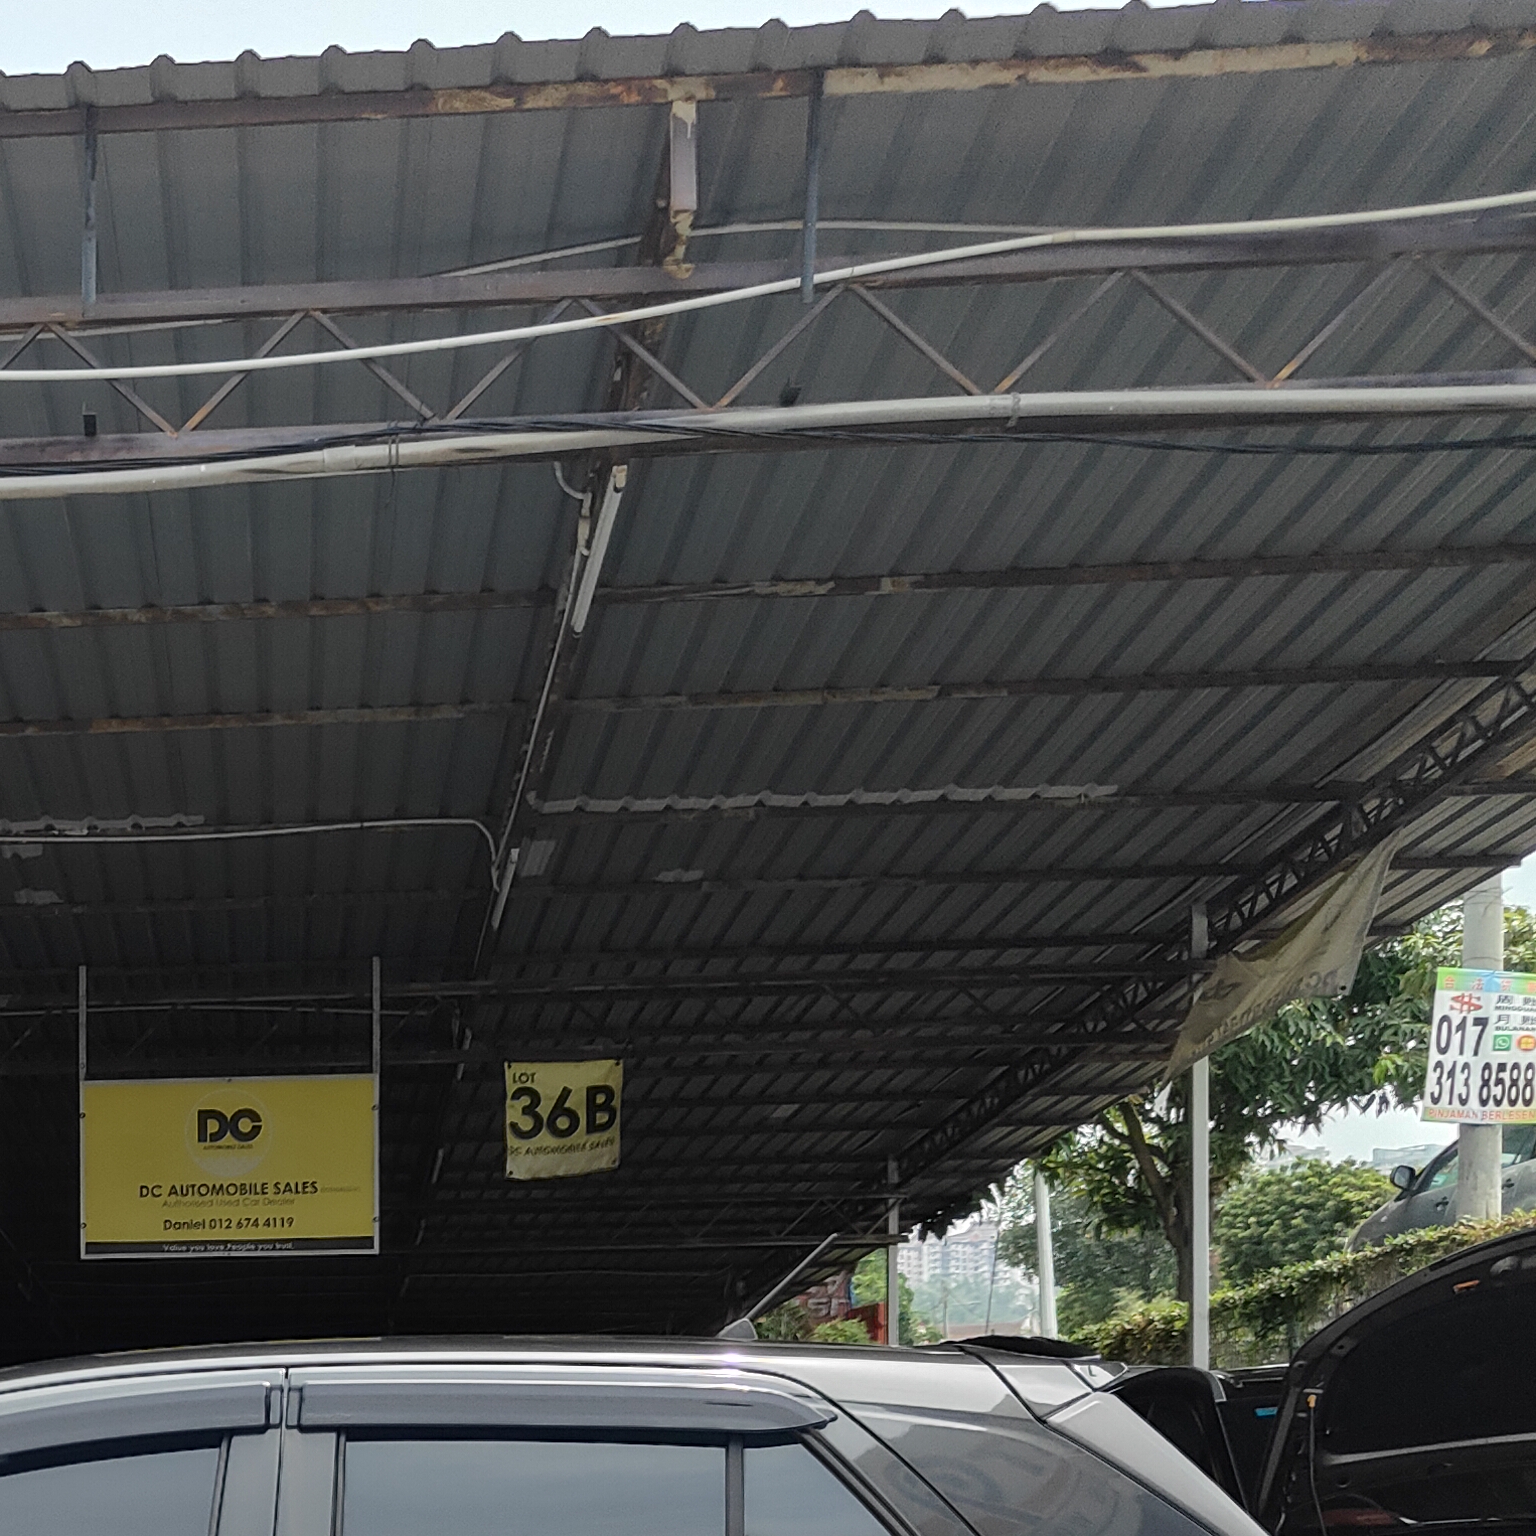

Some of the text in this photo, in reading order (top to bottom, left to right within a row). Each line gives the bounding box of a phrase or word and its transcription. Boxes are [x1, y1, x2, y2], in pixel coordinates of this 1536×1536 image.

[1436, 1014, 1490, 1057] 017
[512, 1072, 536, 1084] LOT
[1430, 1060, 1536, 1108] 313 8588
[509, 1084, 617, 1140] 36B
[1427, 1108, 1536, 1121] PINJAMAN BERLESEN
[197, 1108, 262, 1143] DC
[139, 1184, 163, 1198] DC
[168, 1182, 269, 1198] AUTOMOBILE
[273, 1181, 319, 1195] SALES
[163, 1216, 295, 1231] Daniel 012 674 4119
